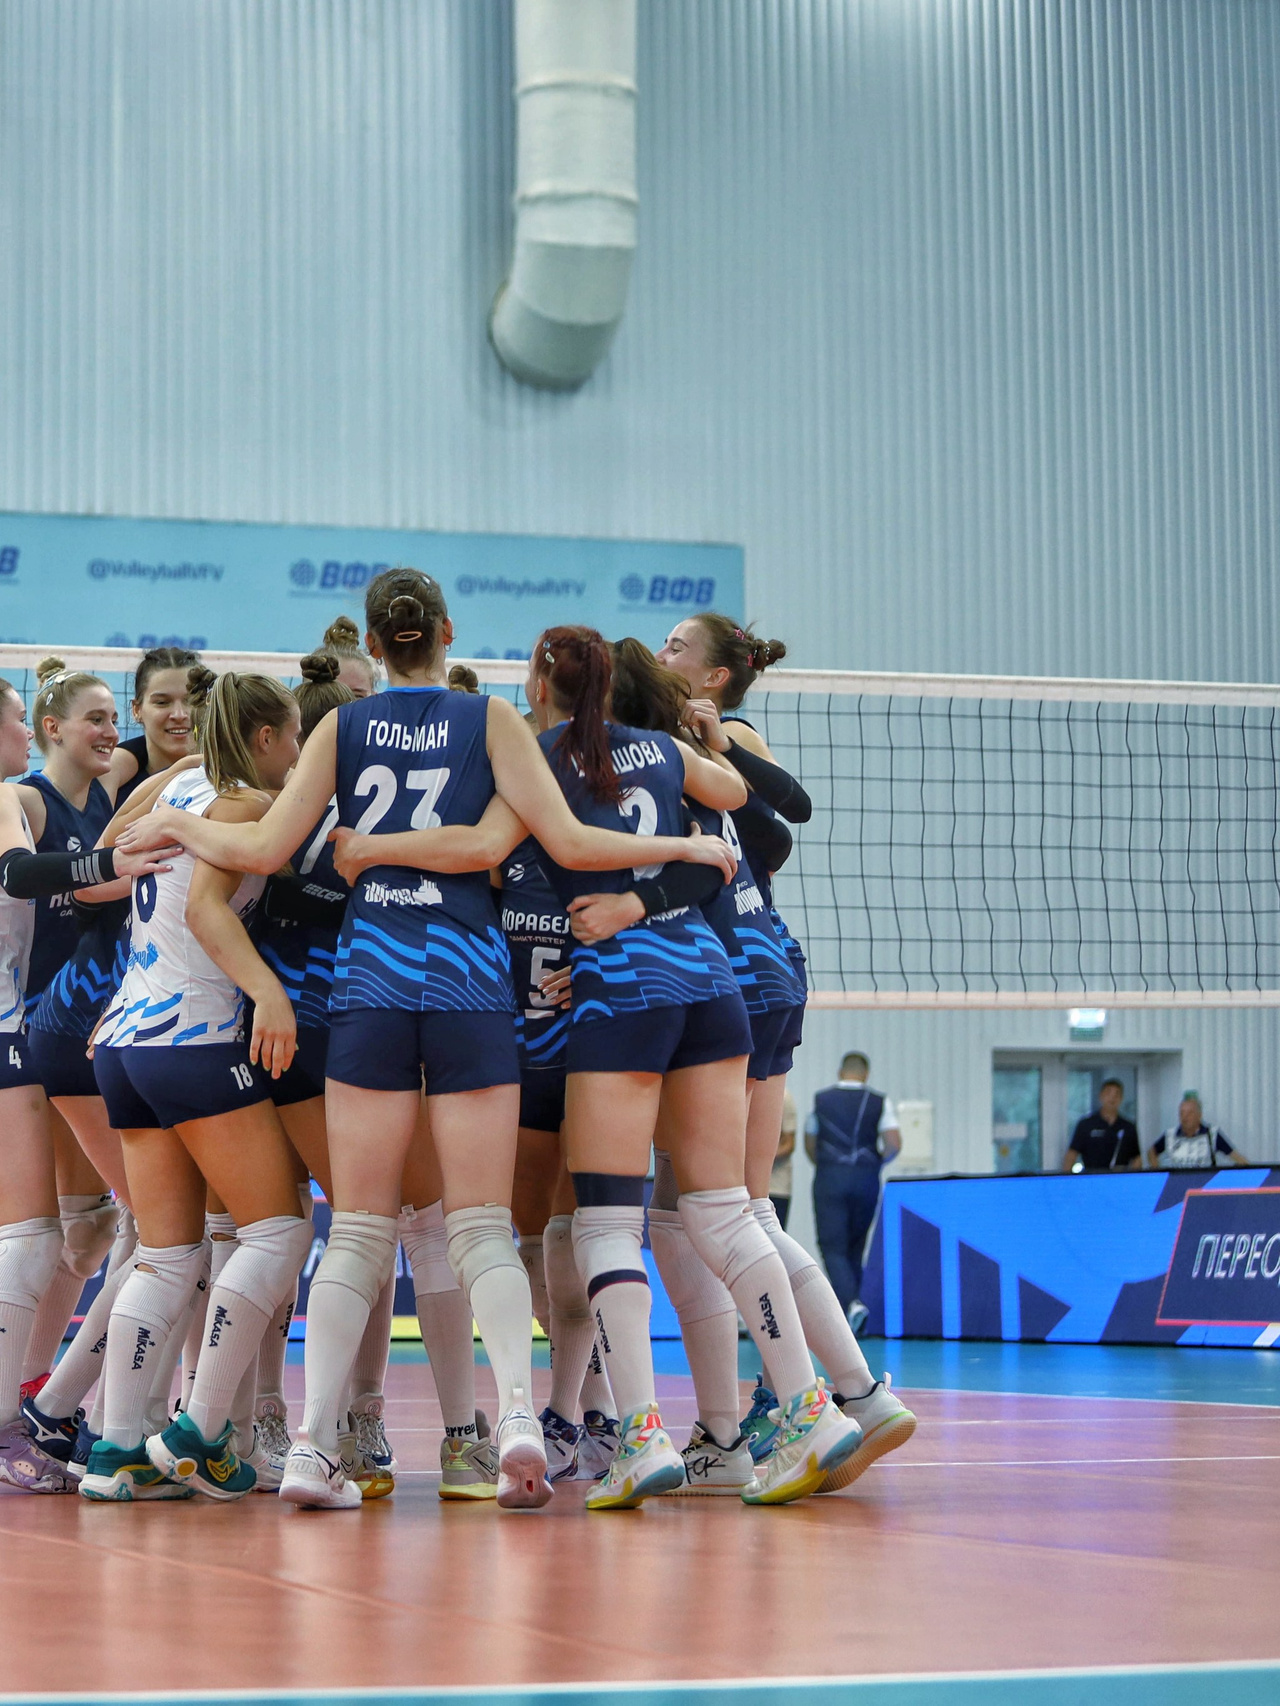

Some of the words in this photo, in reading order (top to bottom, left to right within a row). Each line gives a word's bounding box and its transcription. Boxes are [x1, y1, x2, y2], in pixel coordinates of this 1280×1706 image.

[648, 574, 717, 606] ВФВ
[365, 719, 449, 752] ГОЛЬМАН
[8, 1045, 21, 1069] 4
[230, 1063, 253, 1090] 18
[1192, 1233, 1280, 1280] ПЕРЕО
[209, 1305, 232, 1347] MIKASA
[596, 1308, 611, 1353] MIKASA
[759, 1292, 781, 1339] MIKASA
[132, 1327, 155, 1370] MIKASA
